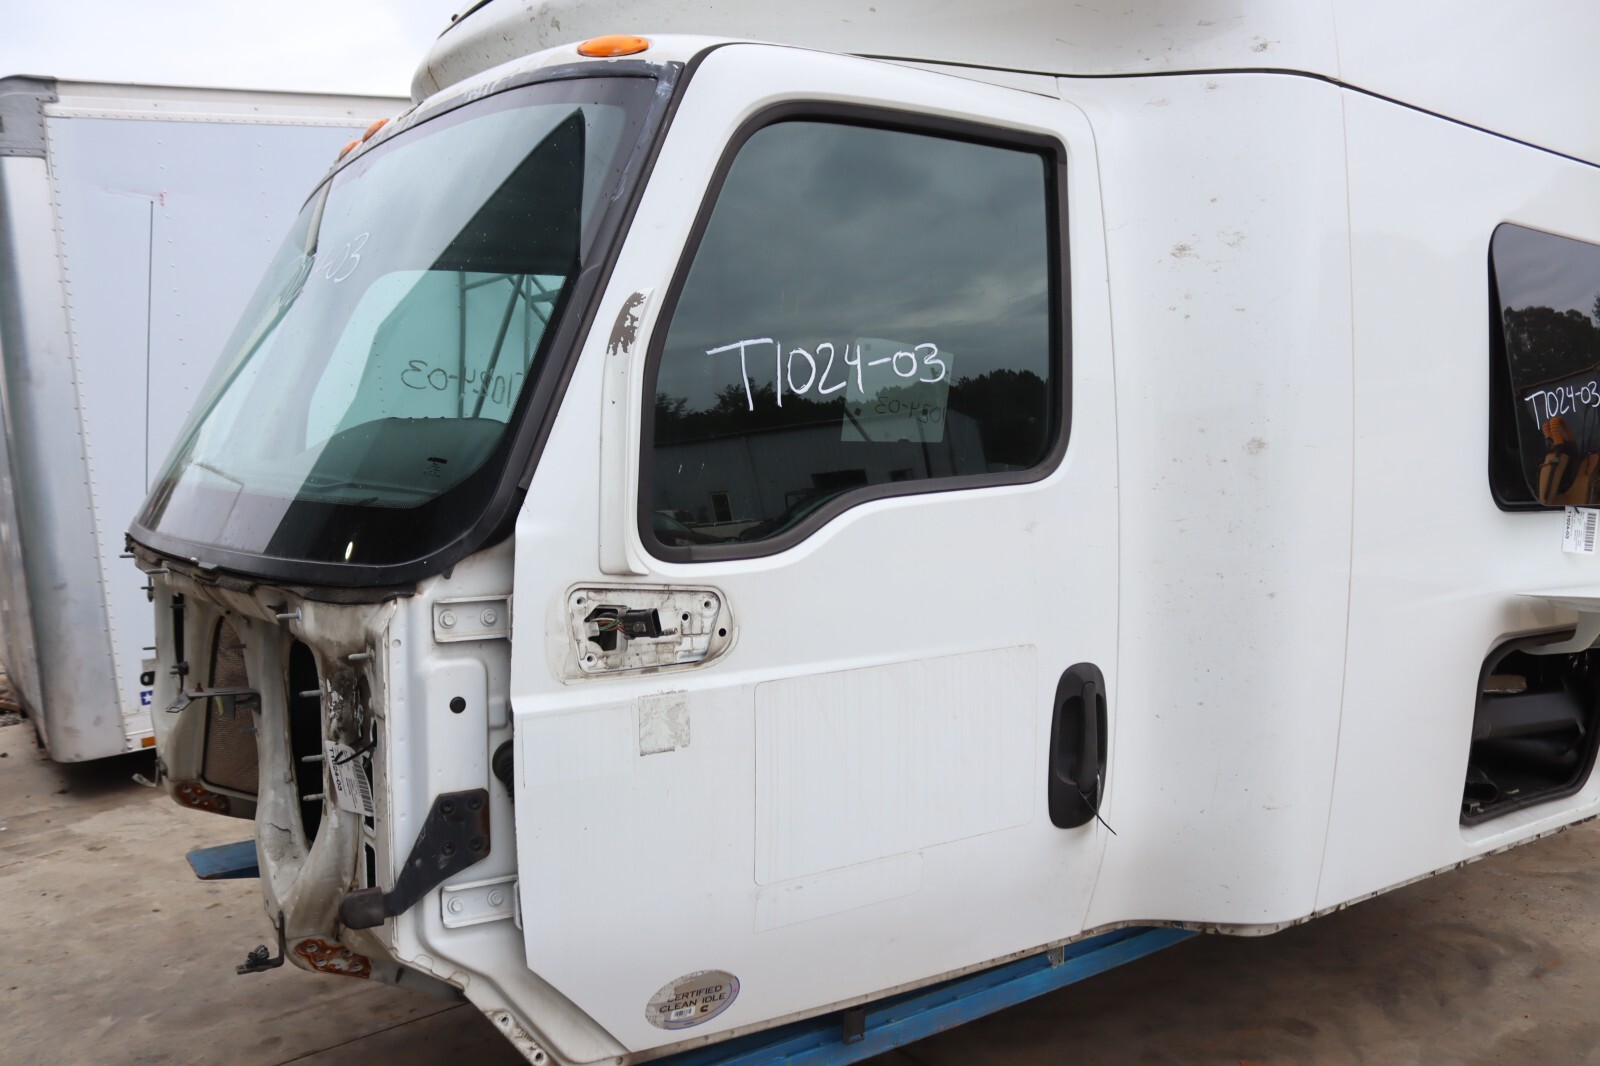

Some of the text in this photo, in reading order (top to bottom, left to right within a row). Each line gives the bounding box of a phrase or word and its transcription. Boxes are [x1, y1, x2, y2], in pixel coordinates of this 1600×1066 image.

[706, 337, 946, 411] T1024-03
[1524, 381, 1600, 430] T1024-03
[659, 992, 727, 1013] CLEAN IDLE
